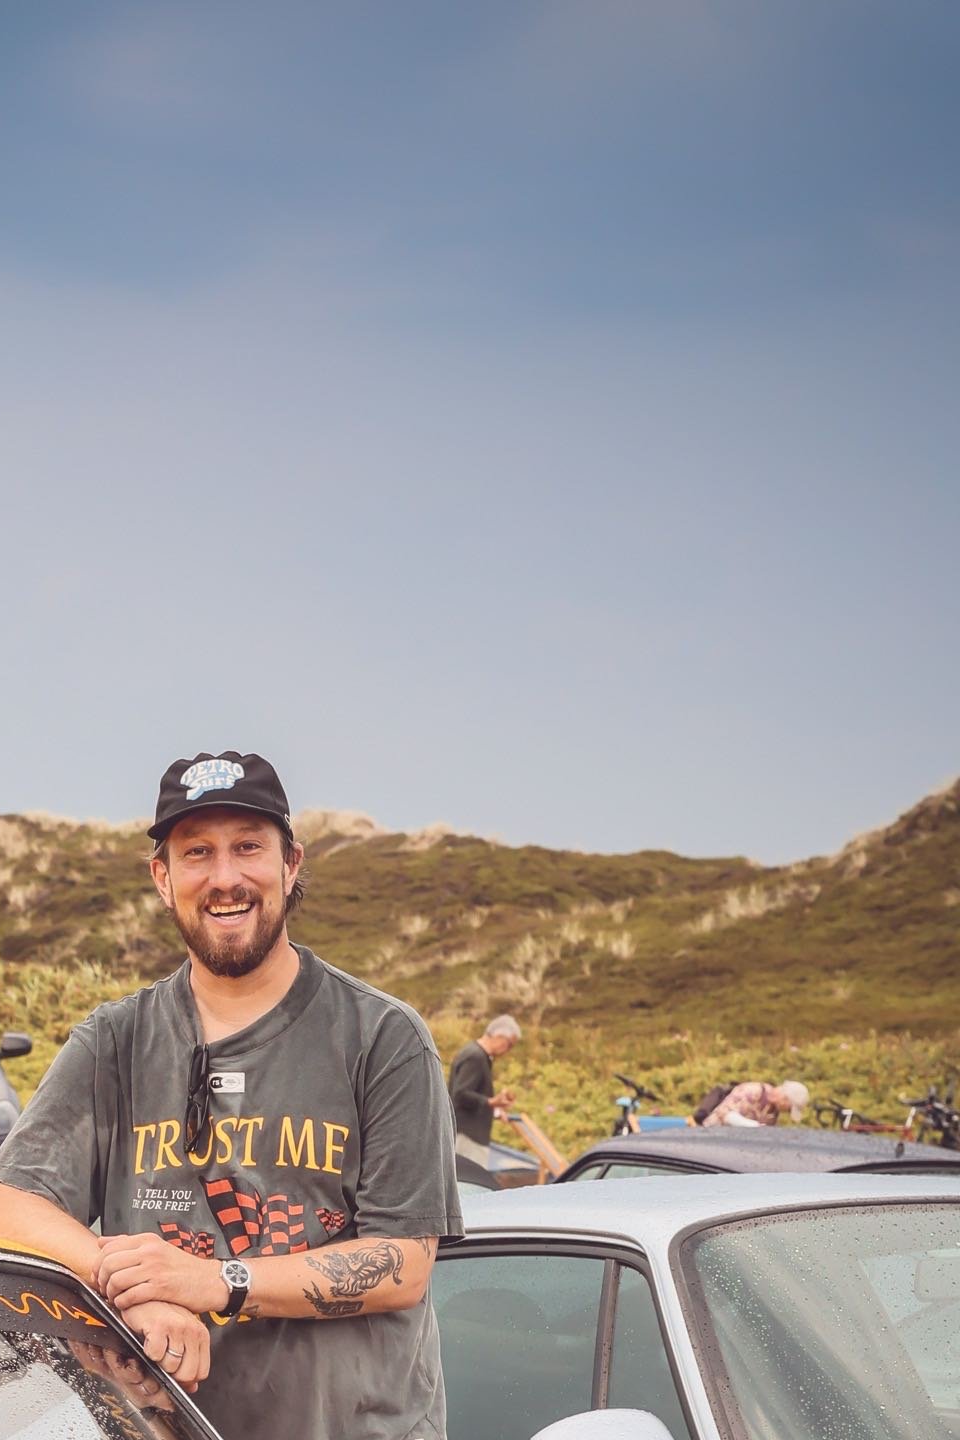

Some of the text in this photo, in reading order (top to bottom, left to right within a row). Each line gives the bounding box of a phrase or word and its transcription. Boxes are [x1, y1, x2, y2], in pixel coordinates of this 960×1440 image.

[180, 759, 245, 787] PETRO
[133, 1115, 349, 1175] TRUST ME
[145, 1188, 169, 1199] TELL
[171, 1189, 192, 1200] YOU
[140, 1199, 162, 1210] FOR
